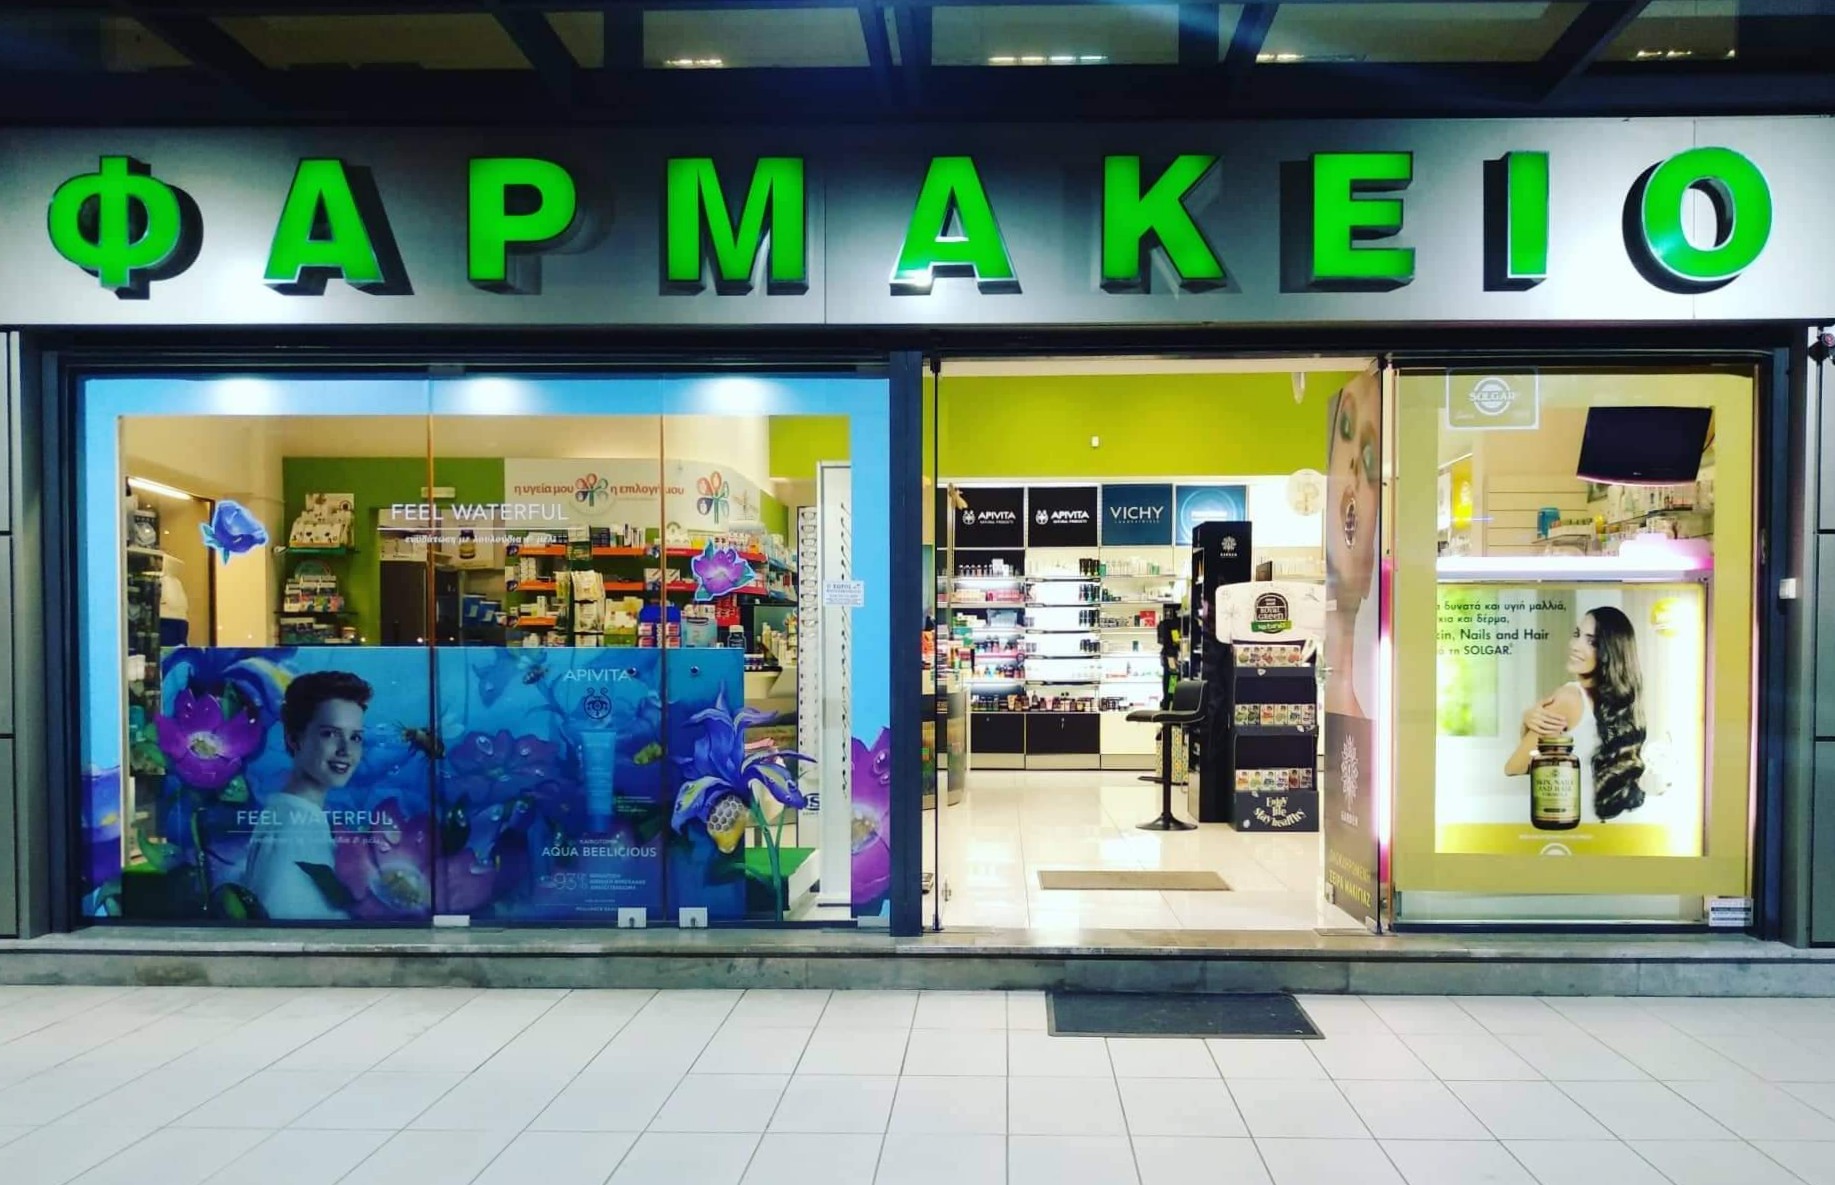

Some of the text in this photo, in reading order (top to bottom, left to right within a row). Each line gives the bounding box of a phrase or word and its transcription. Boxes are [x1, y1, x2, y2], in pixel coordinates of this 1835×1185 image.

[47, 146, 1773, 288] ΦΑΡΜΑΚΕΙΟ
[523, 484, 551, 495] υγεία
[553, 486, 574, 495] μου
[391, 504, 570, 520] FEEL WATERFUL
[978, 511, 1016, 520] APIVITA
[1051, 510, 1090, 519] APIVITA
[1110, 506, 1164, 519] VICHY
[1445, 601, 1481, 611] δυνατά
[1484, 603, 1500, 611] και
[1504, 601, 1526, 613] υγιή
[1529, 600, 1566, 613] μαλλιά,
[1476, 613, 1510, 626] δέρμα,
[1460, 629, 1491, 640] Nails
[1496, 629, 1519, 640] and
[1524, 628, 1549, 641] Hair
[562, 668, 633, 682] APIVITA
[236, 810, 393, 826] FEEL WATERFUL
[541, 846, 657, 858] AQUA BEELICIOUS
